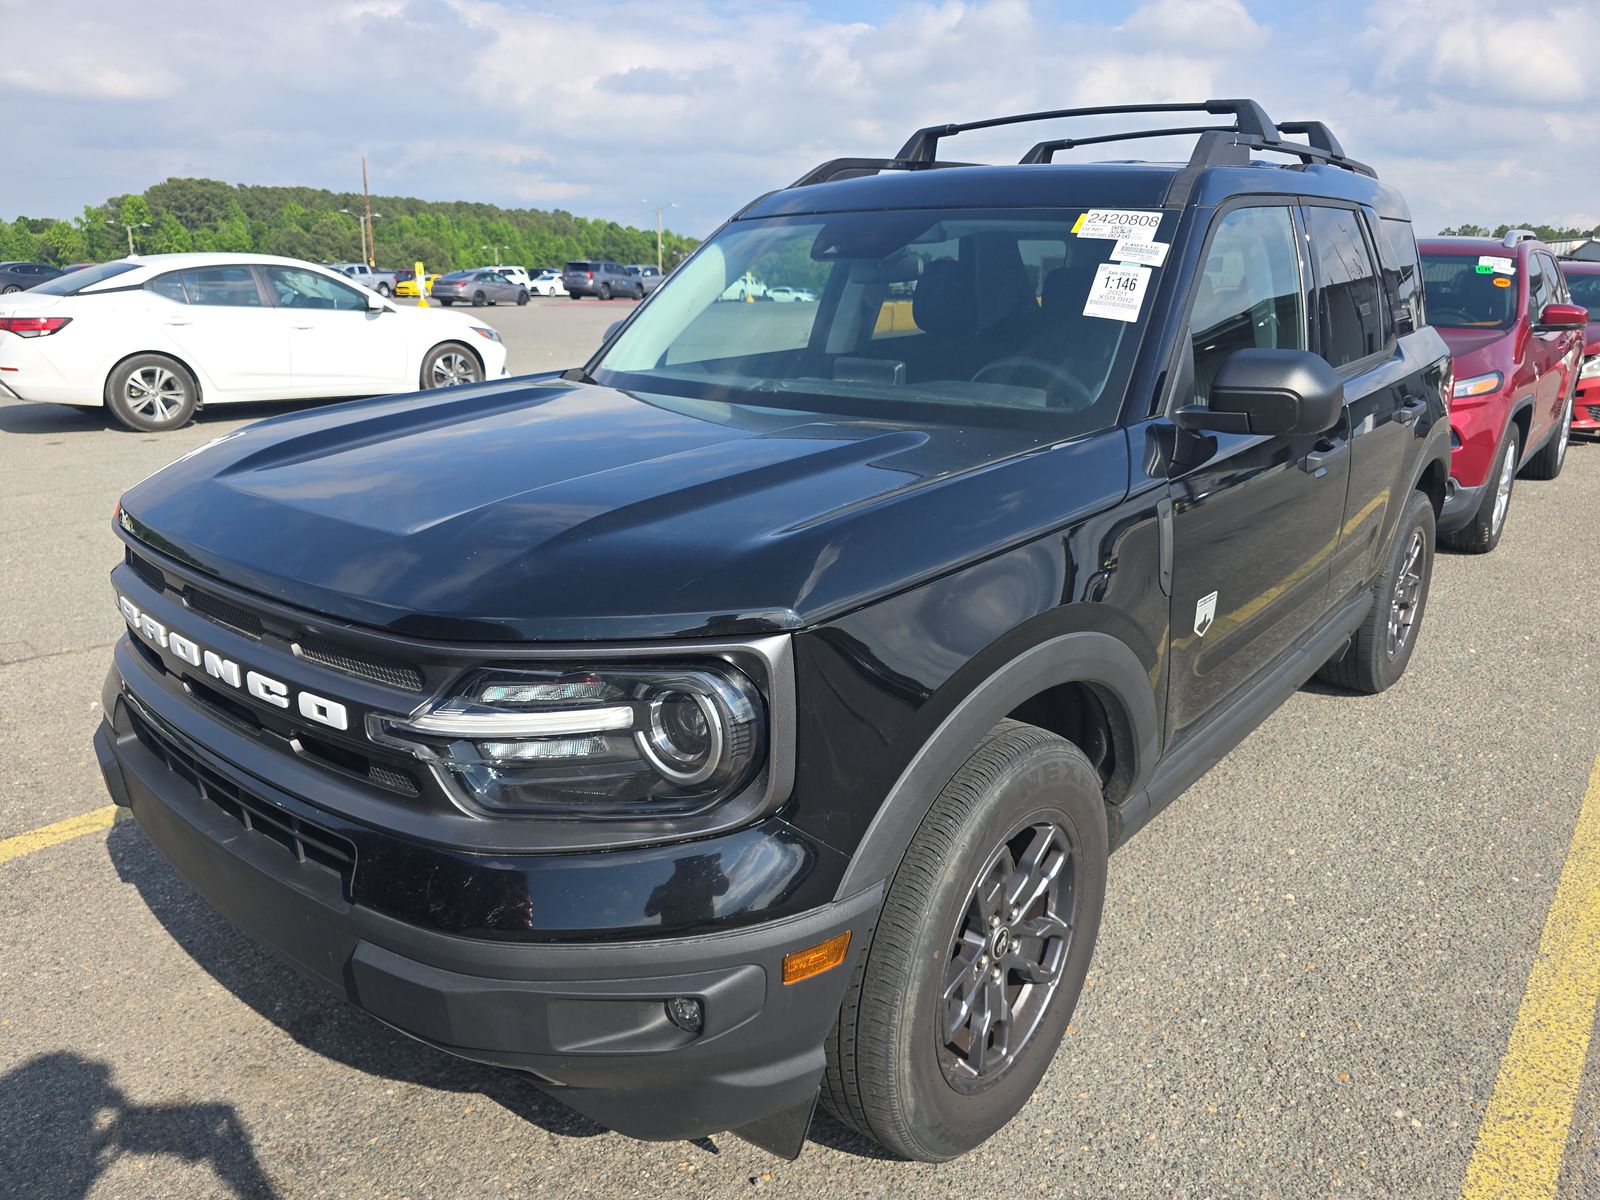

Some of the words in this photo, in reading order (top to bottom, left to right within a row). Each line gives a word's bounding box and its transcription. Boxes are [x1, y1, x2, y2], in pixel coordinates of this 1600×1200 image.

[1088, 213, 1159, 227] 2420808
[1104, 276, 1137, 291] 1:146
[120, 595, 348, 731] BRONCO
